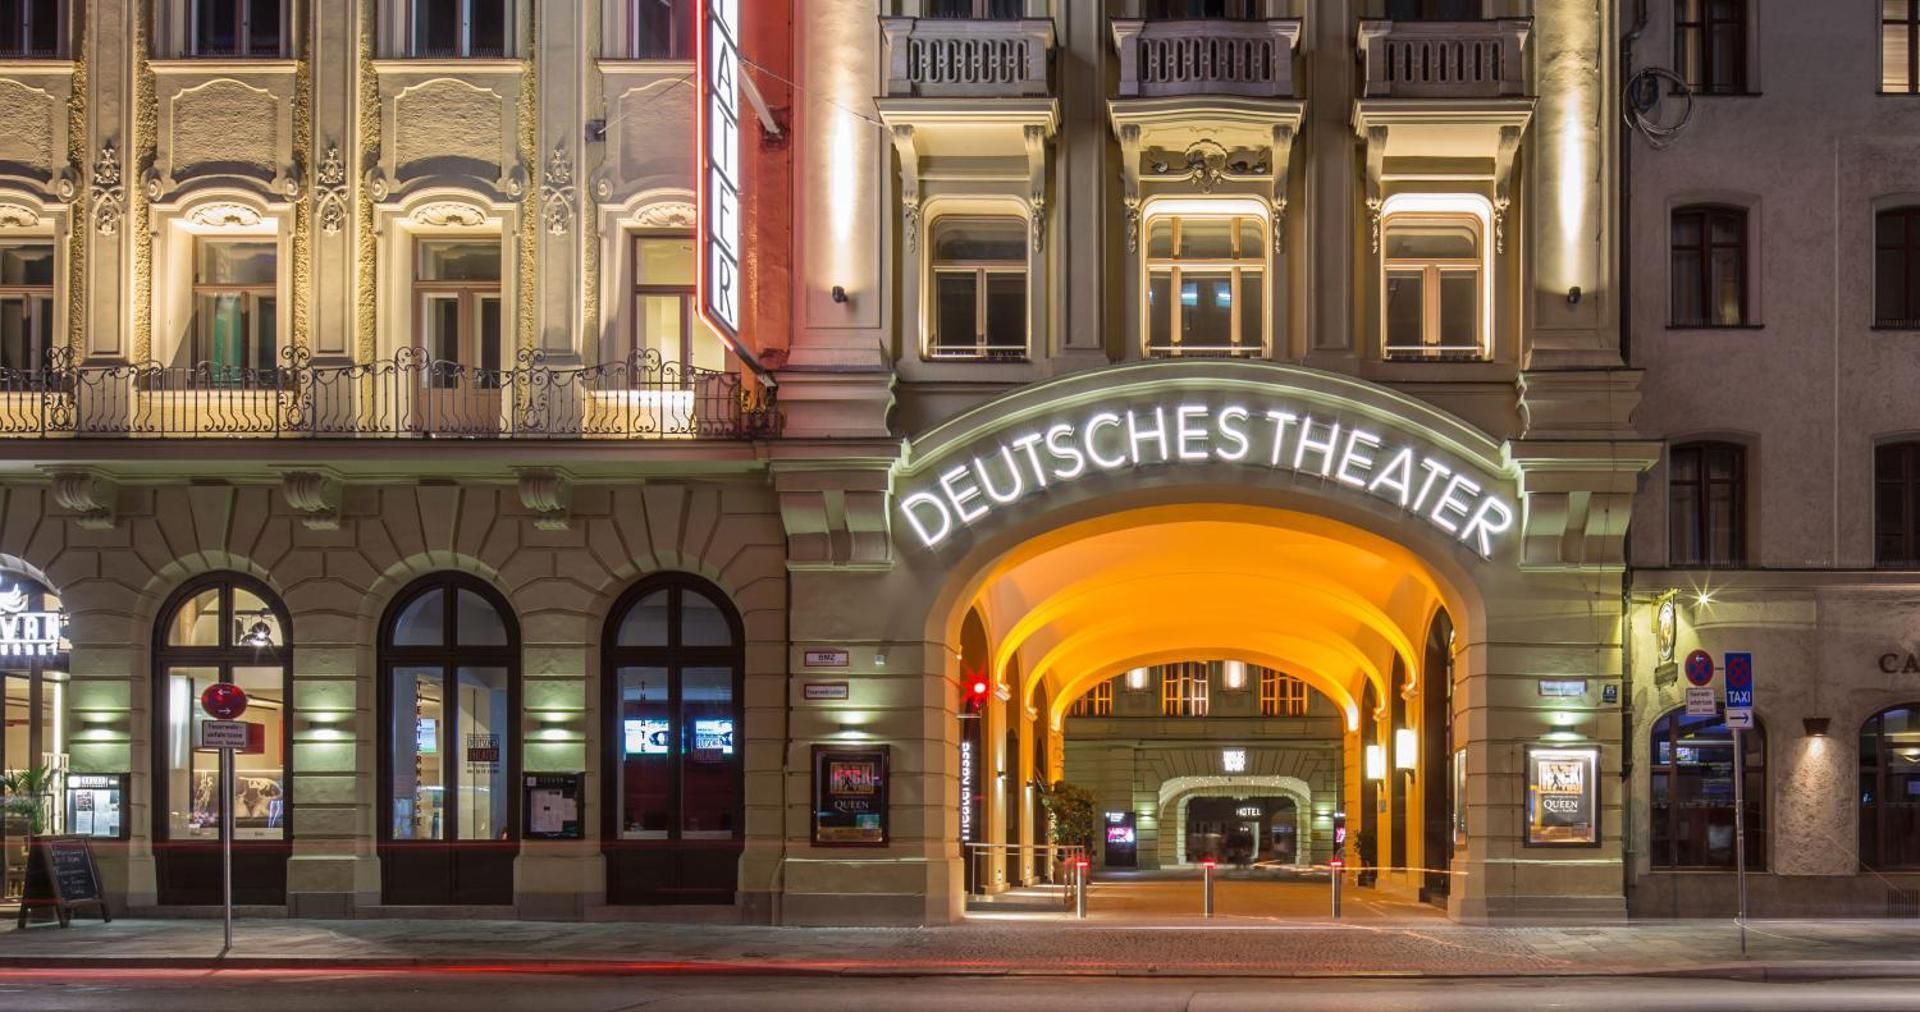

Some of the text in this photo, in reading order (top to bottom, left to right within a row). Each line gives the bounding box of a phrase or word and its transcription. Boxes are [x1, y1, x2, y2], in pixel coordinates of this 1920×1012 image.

[901, 404, 1514, 562] DEUTSCHES THEATER
[1728, 691, 1751, 703] TAXI
[834, 800, 869, 813] QUEEN
[1235, 808, 1261, 816] HOTEL
[1543, 799, 1578, 812] QUEEN
